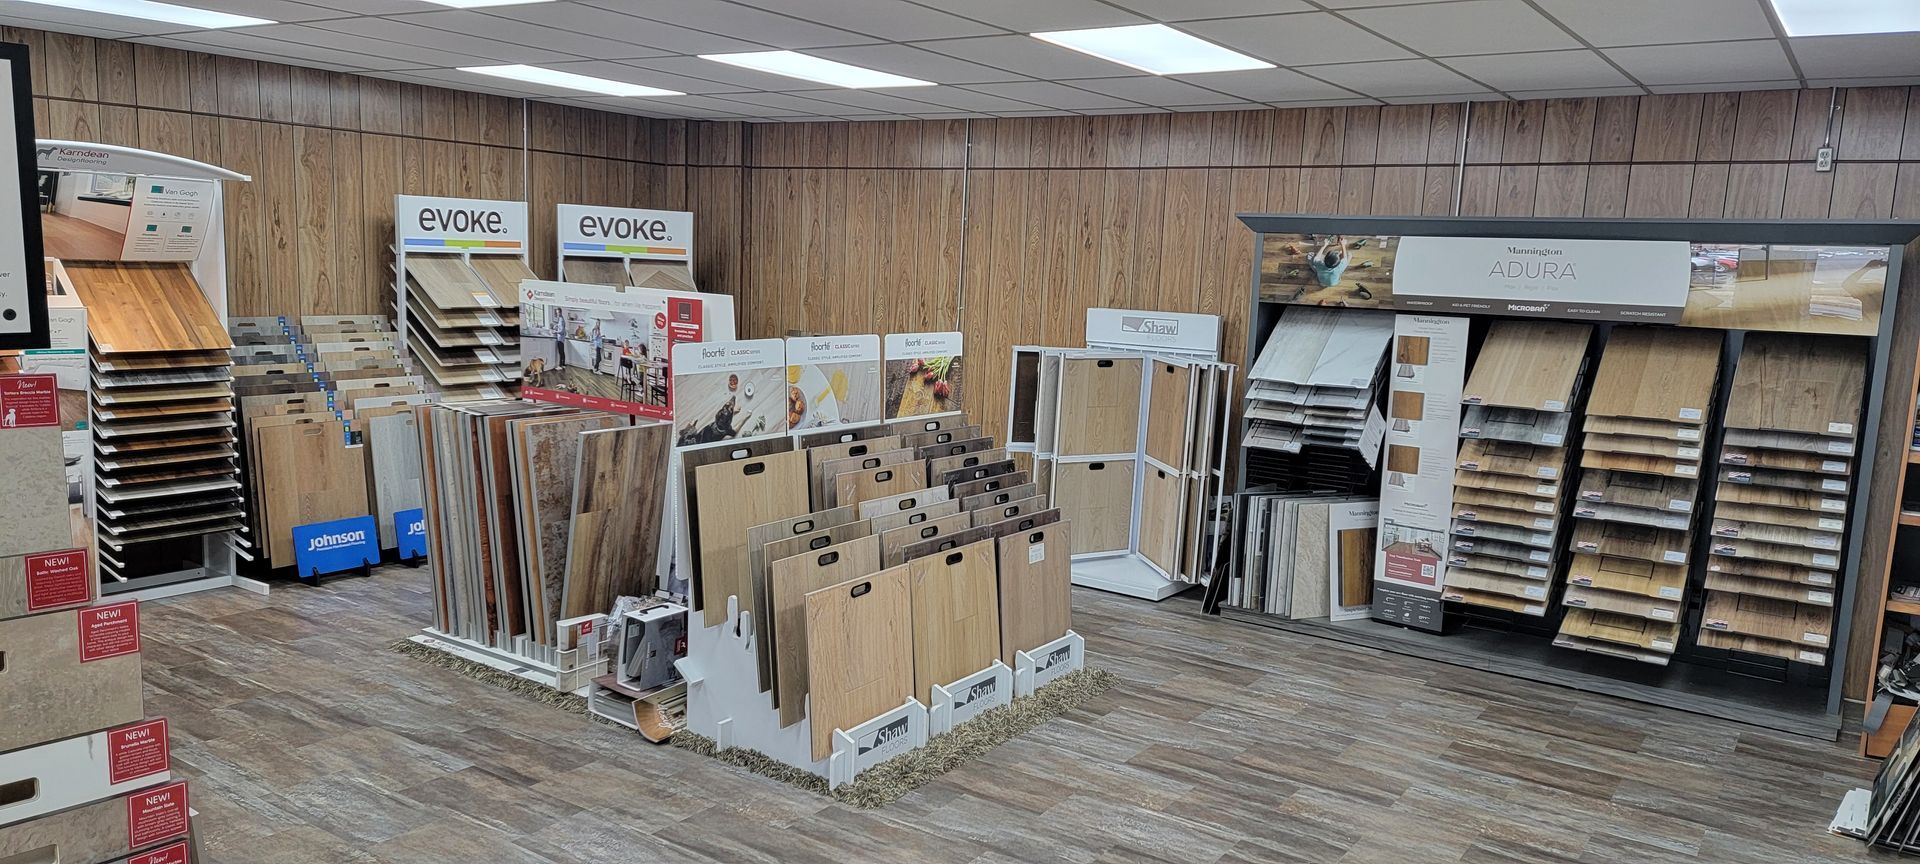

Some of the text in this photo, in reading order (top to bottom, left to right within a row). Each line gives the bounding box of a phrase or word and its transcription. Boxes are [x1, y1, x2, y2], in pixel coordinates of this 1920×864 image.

[58, 147, 110, 159] Karndean
[164, 188, 199, 198] Van Gogh
[1507, 246, 1563, 257] Mannington
[1143, 320, 1176, 334] Shaw
[1413, 316, 1450, 326] Mannington
[44, 556, 70, 568] NEW!
[96, 608, 121, 621] NEW!
[103, 618, 128, 627] Parchment
[1049, 650, 1071, 668] Shaw
[970, 680, 996, 702] Shaw
[972, 694, 996, 712] FLOORS
[125, 728, 150, 742] NEW!
[878, 721, 908, 745] Shaw
[139, 737, 156, 745] Marble
[881, 736, 908, 755] FLOORS
[145, 792, 170, 806] NEW!
[142, 801, 175, 814] Mountain Slate
